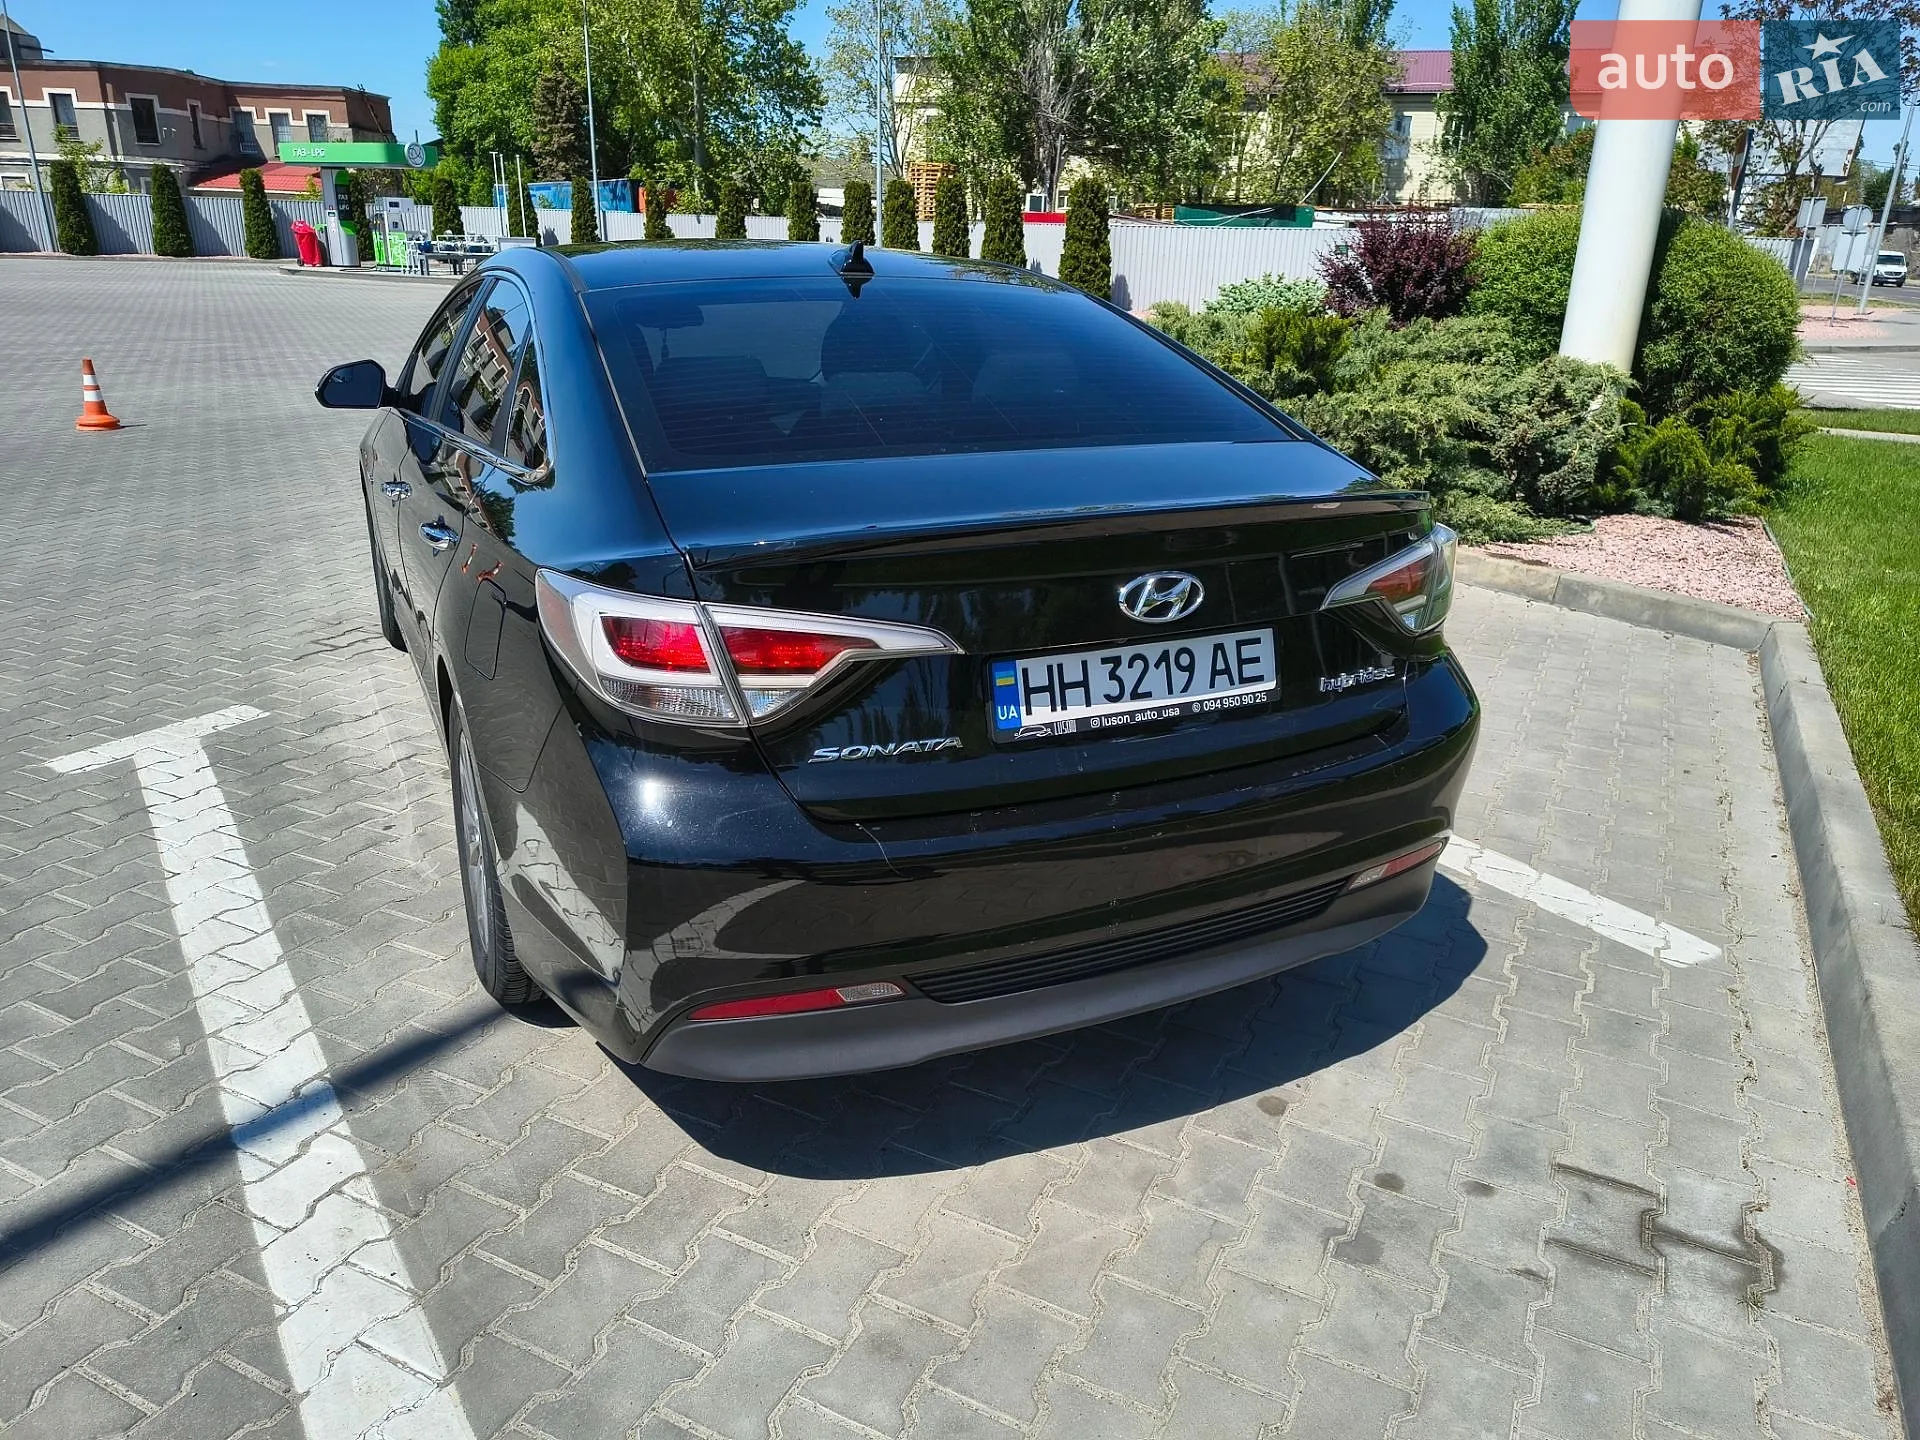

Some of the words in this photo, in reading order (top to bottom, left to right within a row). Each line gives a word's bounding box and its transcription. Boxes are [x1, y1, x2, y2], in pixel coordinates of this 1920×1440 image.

[1021, 659, 1092, 716] HH
[1100, 646, 1196, 704] 3219
[1208, 636, 1265, 689] AE
[1203, 699, 1222, 711] 094
[1222, 696, 1241, 708] 950
[1242, 694, 1254, 705] 90
[1255, 692, 1267, 703] 25
[997, 705, 1019, 721] UA
[1101, 707, 1180, 728] luson_auto_usa
[807, 736, 963, 764] SONATA
